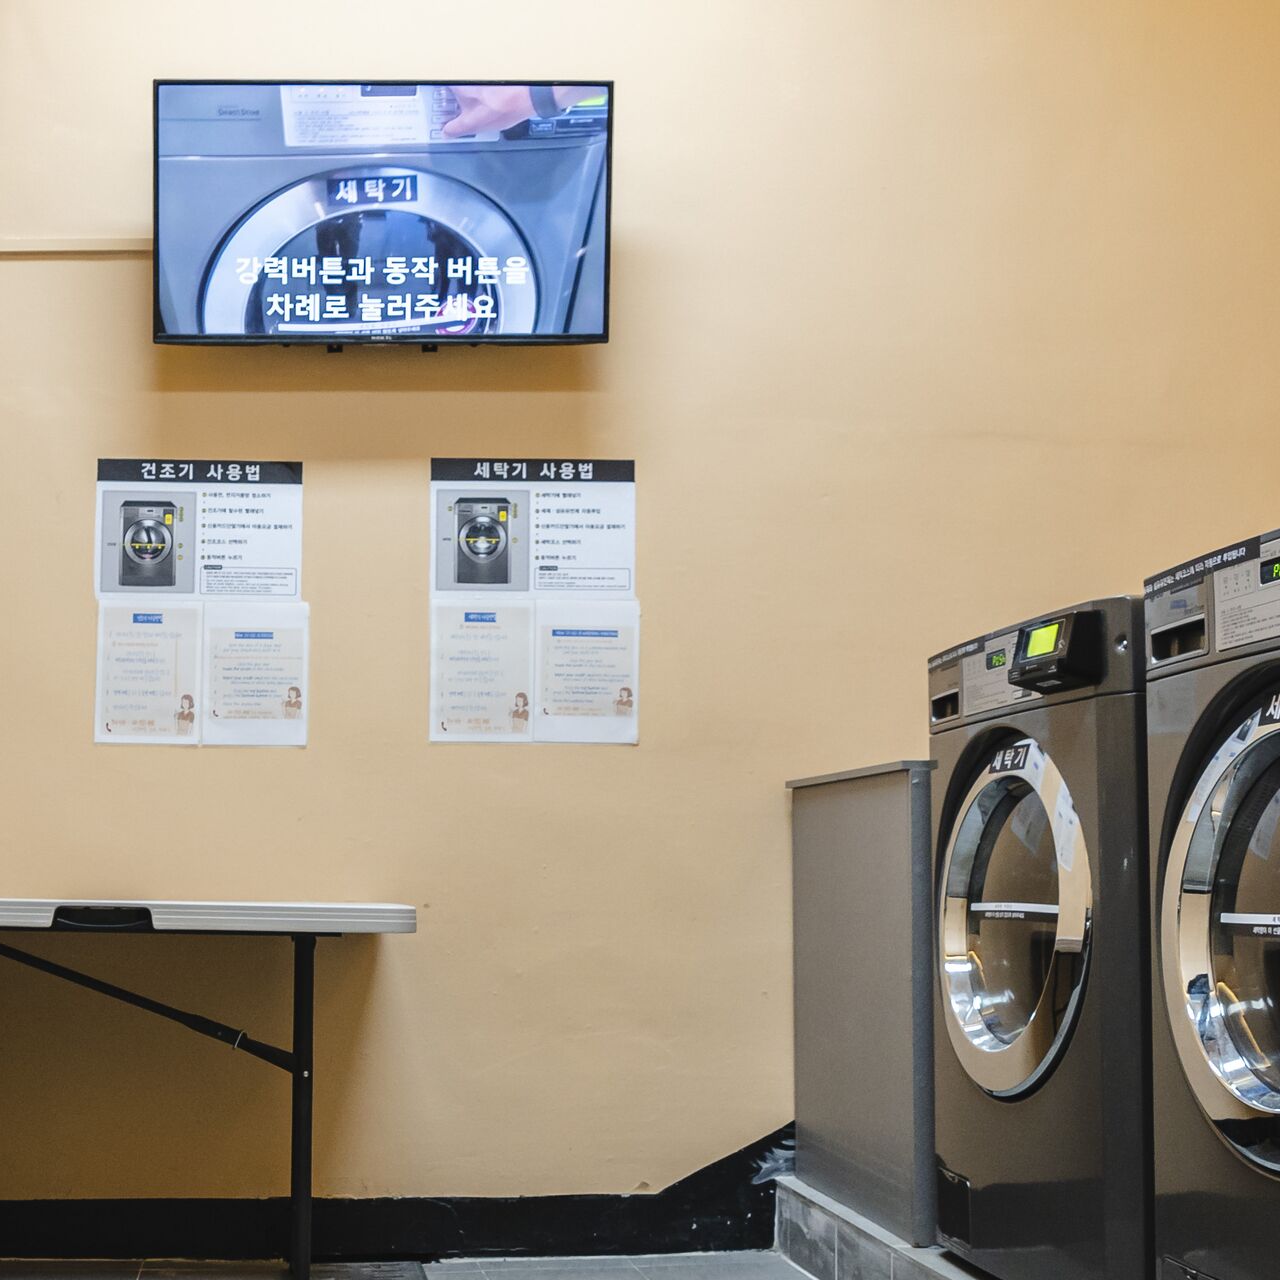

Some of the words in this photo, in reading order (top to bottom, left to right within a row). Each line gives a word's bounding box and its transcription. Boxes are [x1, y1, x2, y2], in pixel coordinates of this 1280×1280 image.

[336, 178, 412, 203] 세탁기
[236, 257, 374, 285] 강력버튼과
[383, 257, 438, 285] 동작
[447, 256, 530, 285] 버튼을
[267, 294, 350, 322] 차례로
[358, 293, 498, 322] 눌러주세요
[141, 462, 194, 480] 건조기
[206, 464, 260, 482] 사용법
[473, 461, 527, 479] 세탁기
[539, 462, 593, 480] 사용법
[992, 747, 1025, 770] 세탁기
